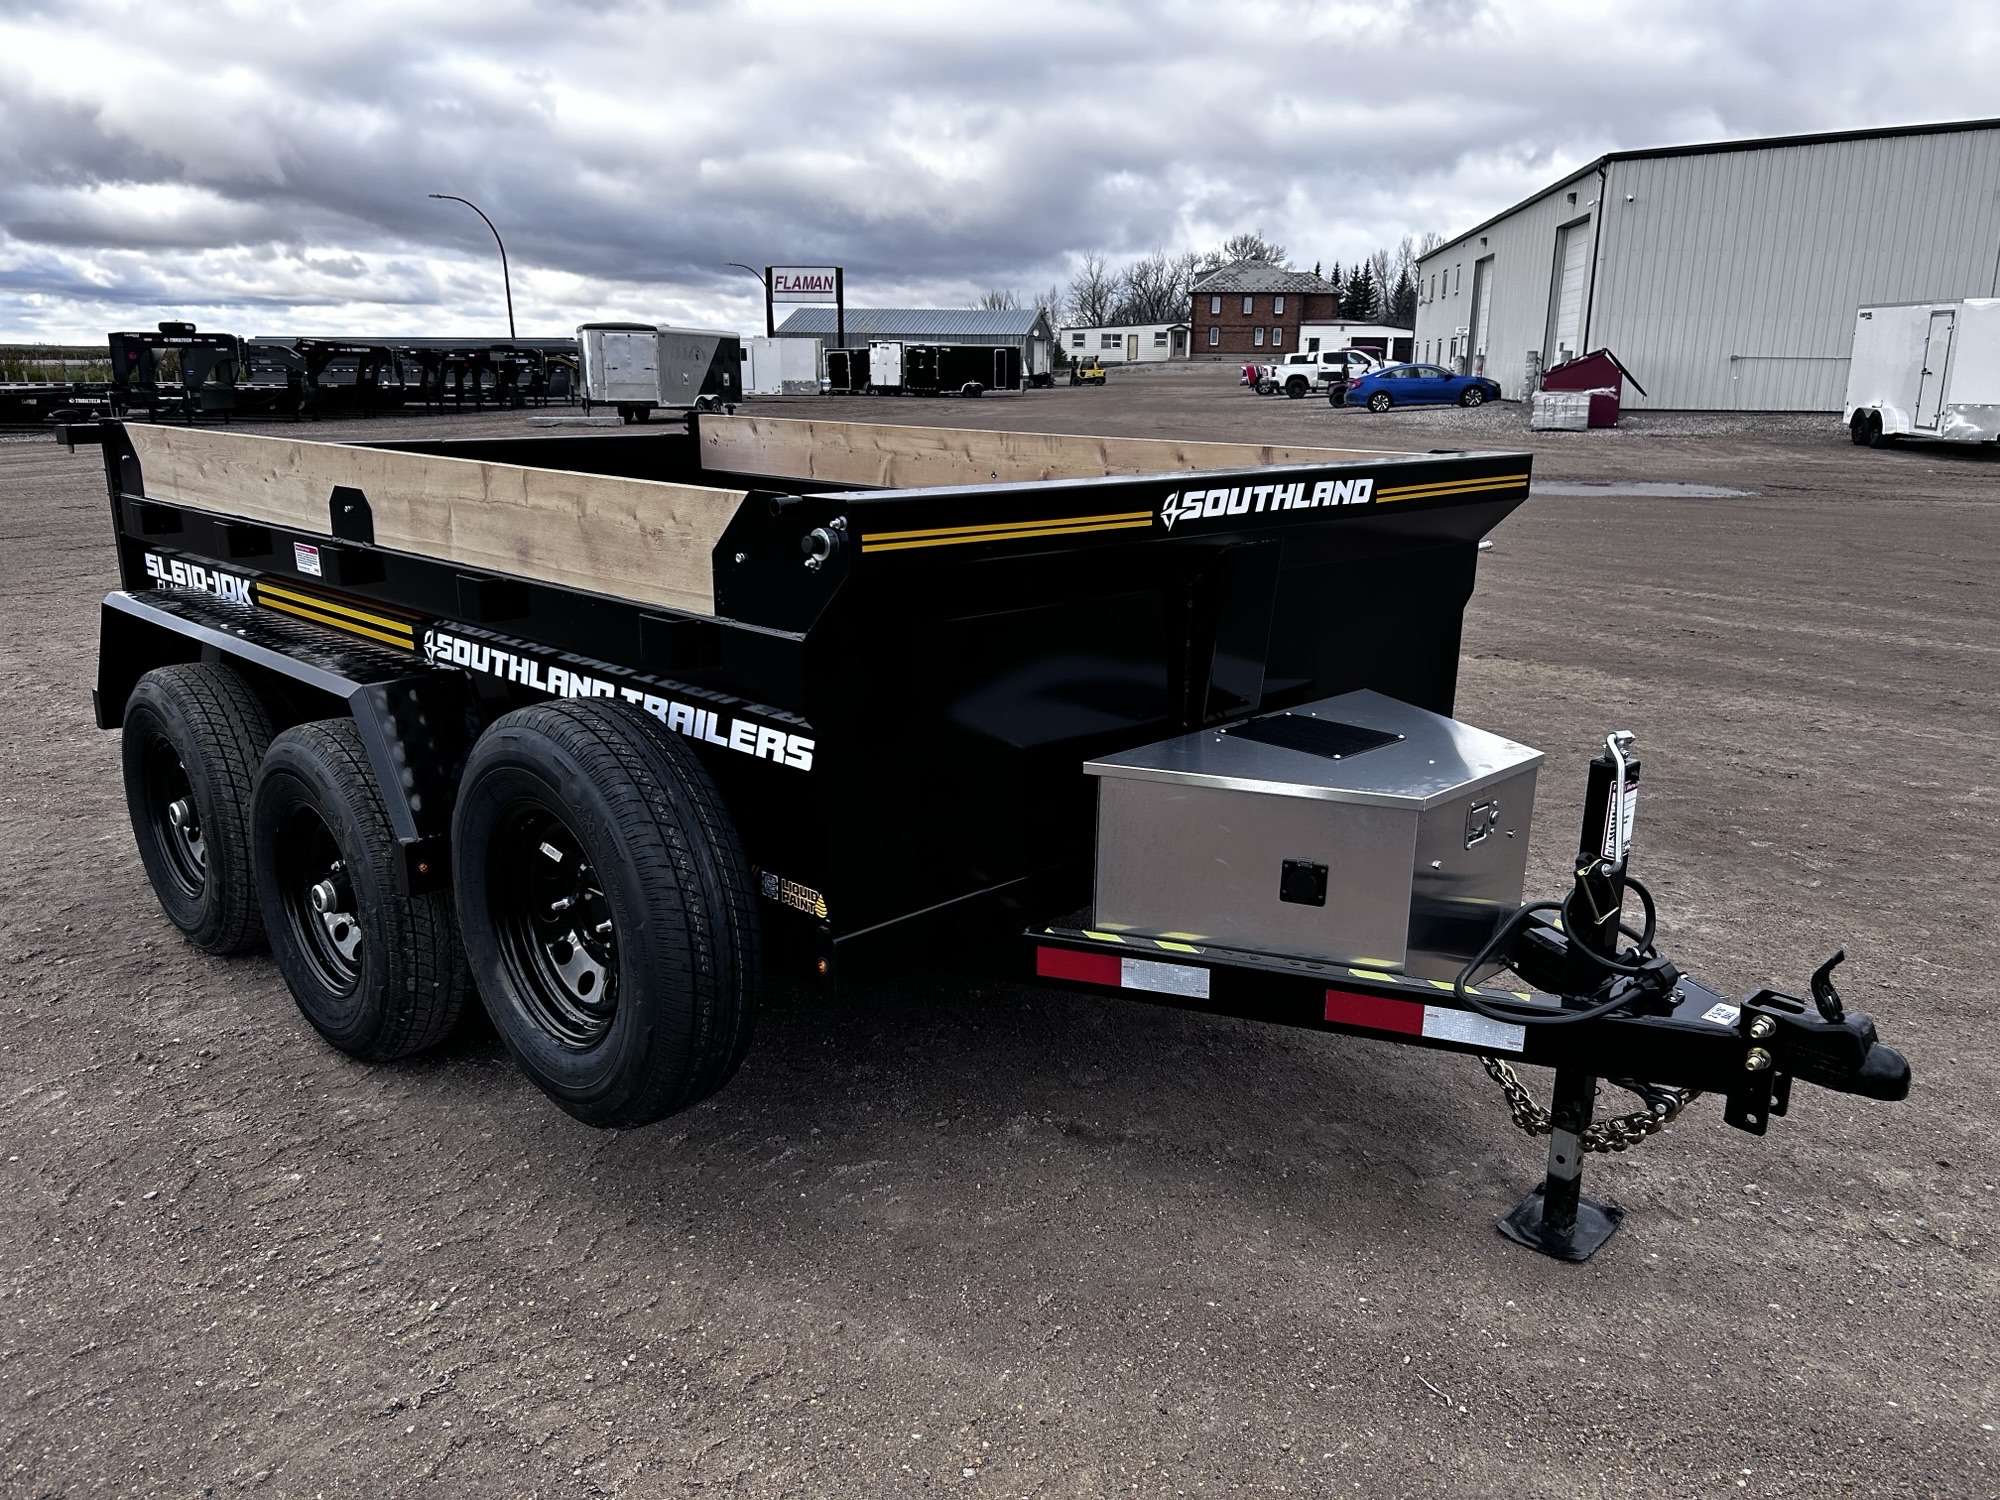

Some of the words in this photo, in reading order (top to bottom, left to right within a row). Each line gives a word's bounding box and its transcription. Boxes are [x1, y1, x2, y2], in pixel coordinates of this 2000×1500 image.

[775, 275, 834, 290] FLAMAN
[1180, 479, 1373, 520] SOUTHLAND
[436, 632, 615, 698] SOUTHLAND
[621, 687, 816, 772] TRAILERS
[781, 878, 820, 901] LIQUID
[781, 889, 816, 914] PAINT
